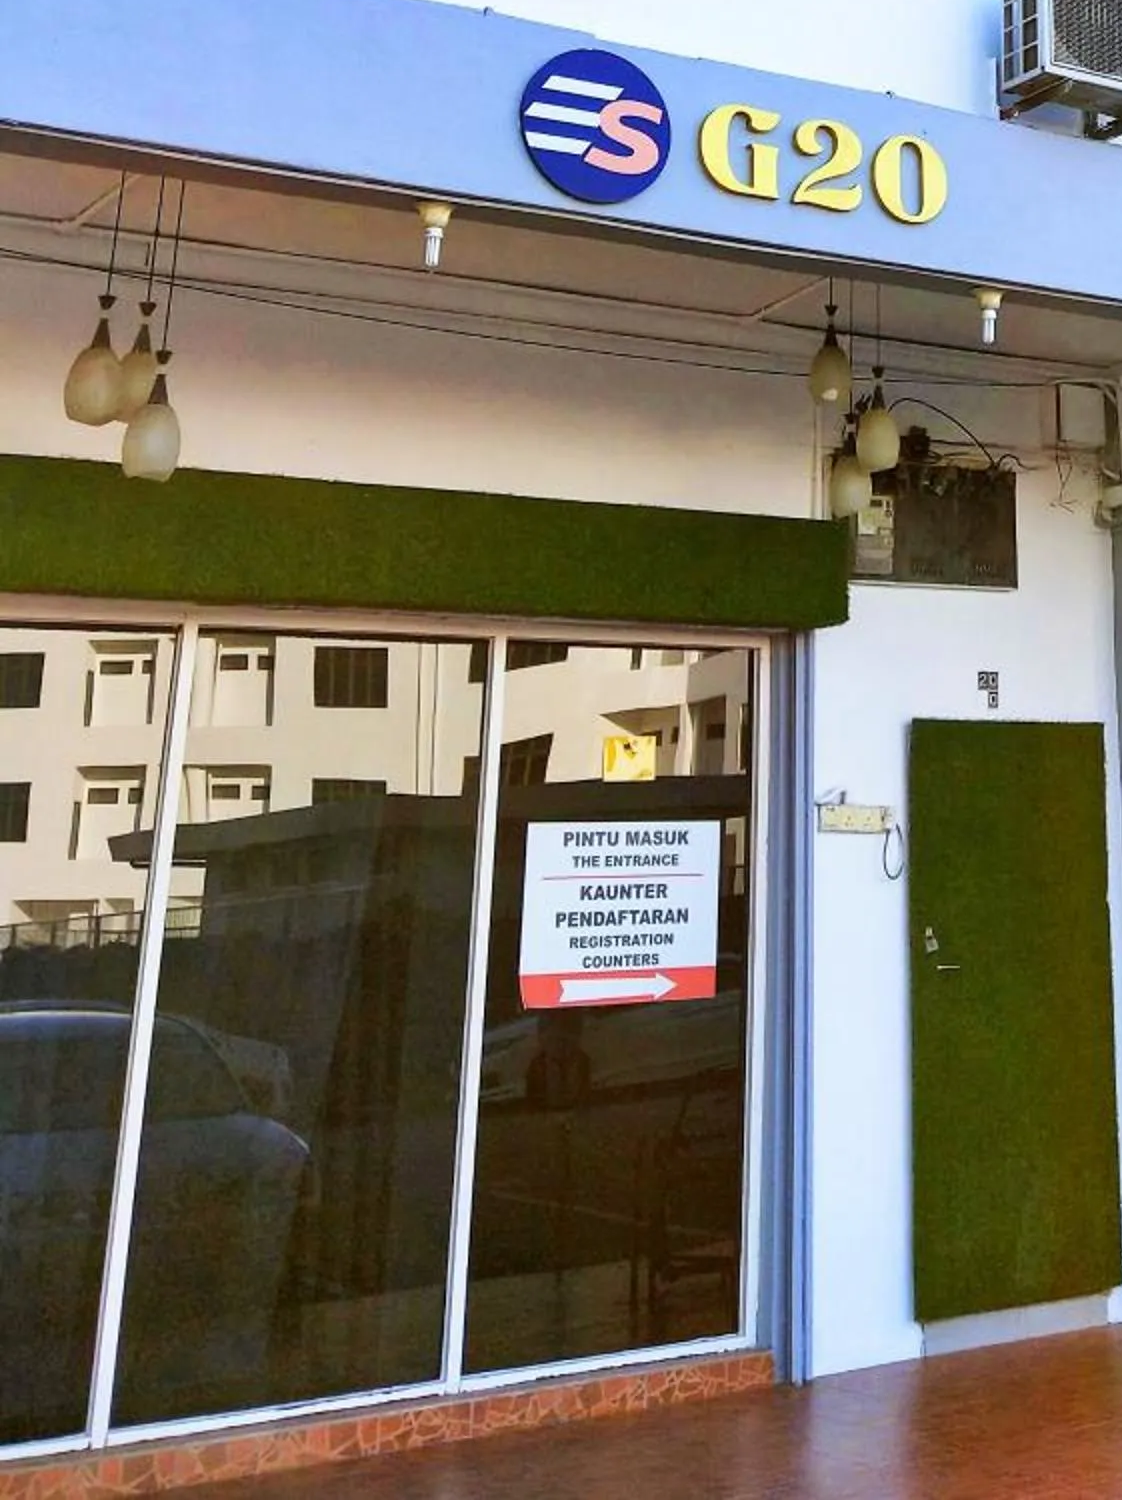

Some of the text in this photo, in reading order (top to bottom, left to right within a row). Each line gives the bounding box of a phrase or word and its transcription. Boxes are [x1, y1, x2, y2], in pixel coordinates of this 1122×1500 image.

[699, 102, 948, 225] G20
[563, 830, 689, 847] PINTU MASUK
[572, 853, 679, 868] THE ENTRANCE
[579, 883, 668, 900] KAUNTER
[555, 908, 689, 928] PENDAFTARAN
[569, 933, 674, 949] REGISTRATION
[582, 953, 660, 969] COUNTERS
